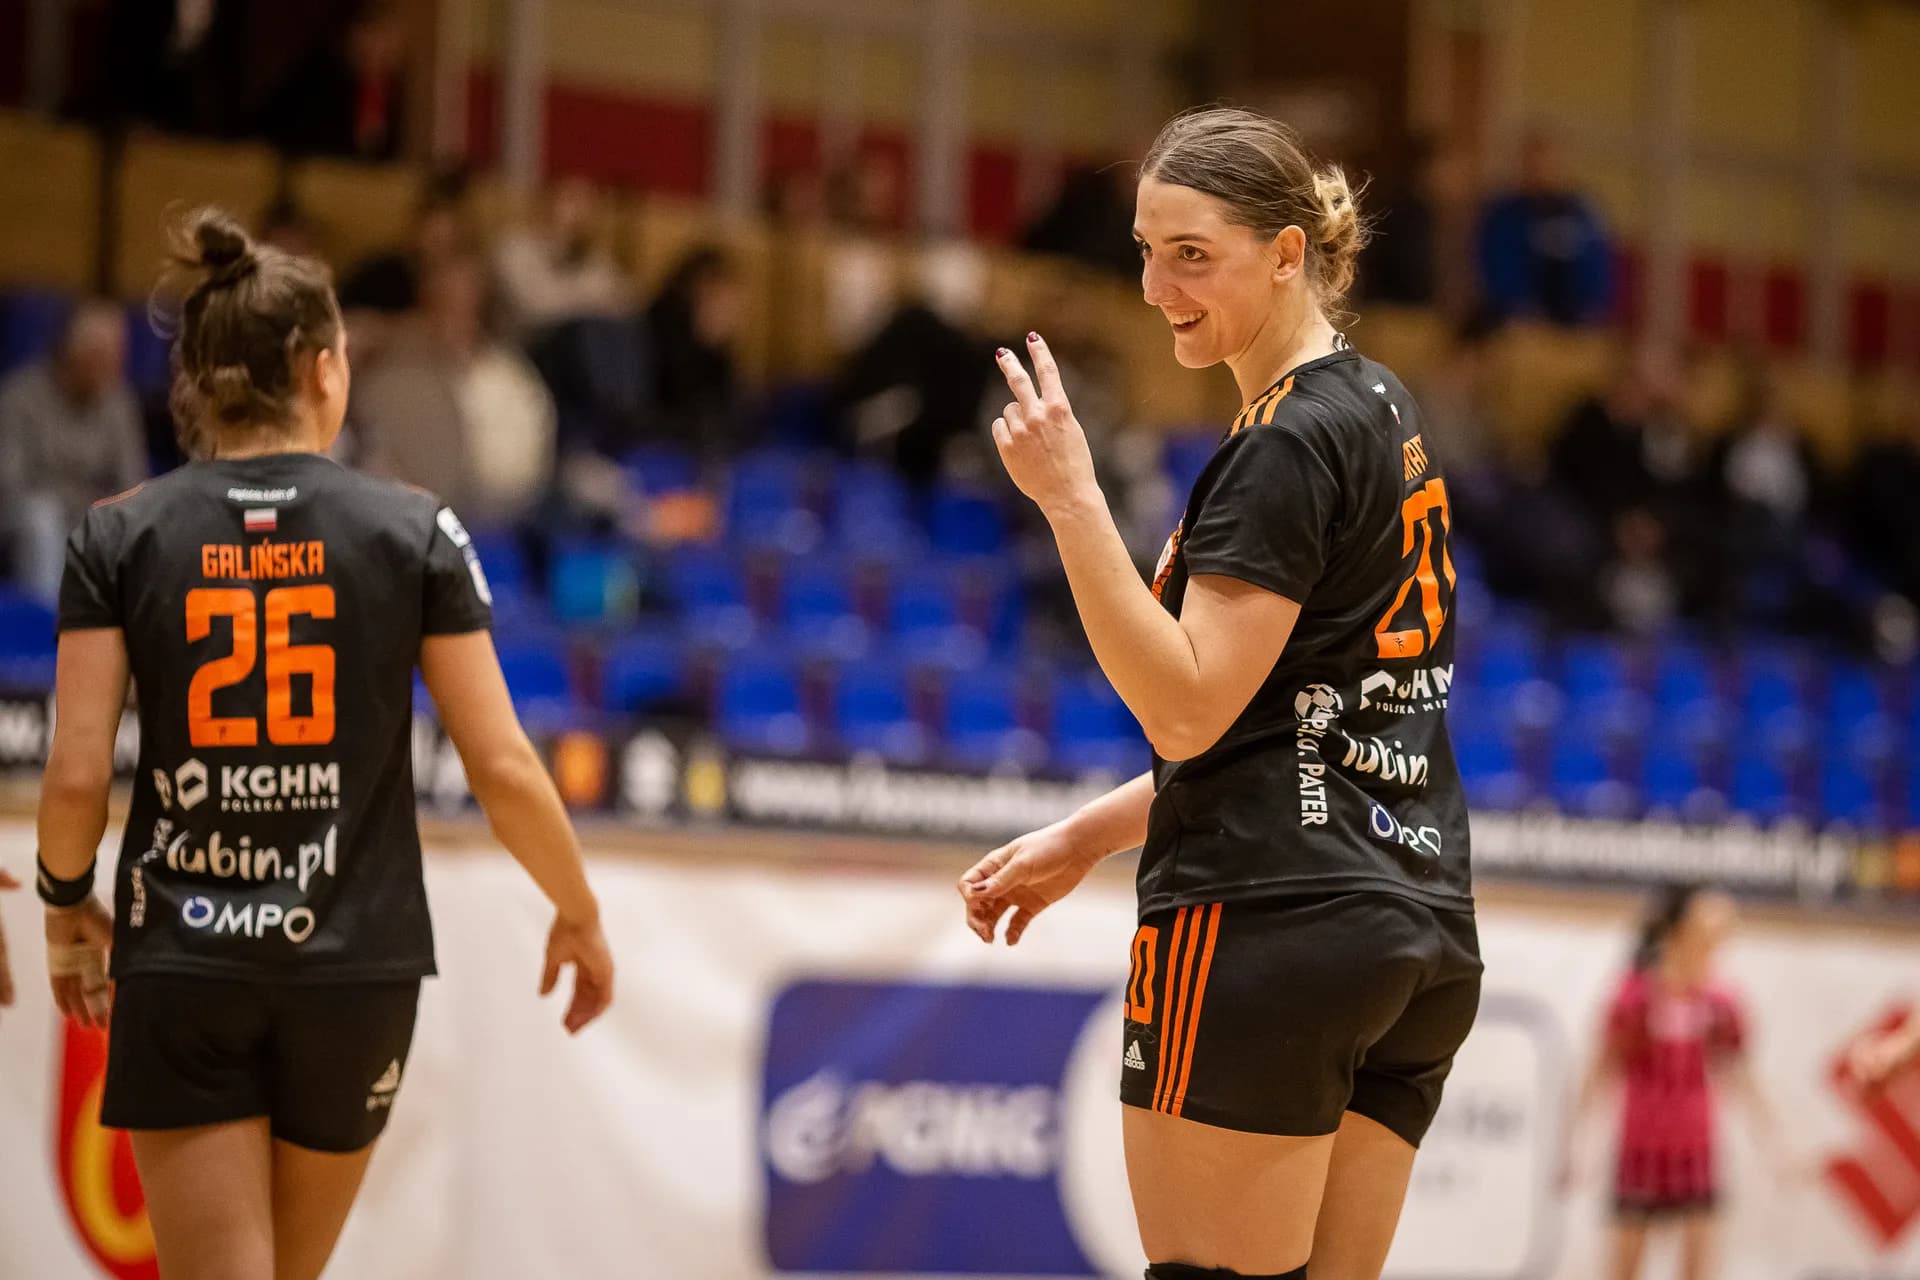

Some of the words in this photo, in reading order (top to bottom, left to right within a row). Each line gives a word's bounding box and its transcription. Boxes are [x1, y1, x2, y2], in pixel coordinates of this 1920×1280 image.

[202, 538, 325, 579] GALIŃSKA
[185, 585, 336, 747] 26
[1376, 701, 1415, 715] POLSKA
[221, 762, 340, 798] KGHM
[1298, 763, 1329, 827] PATER
